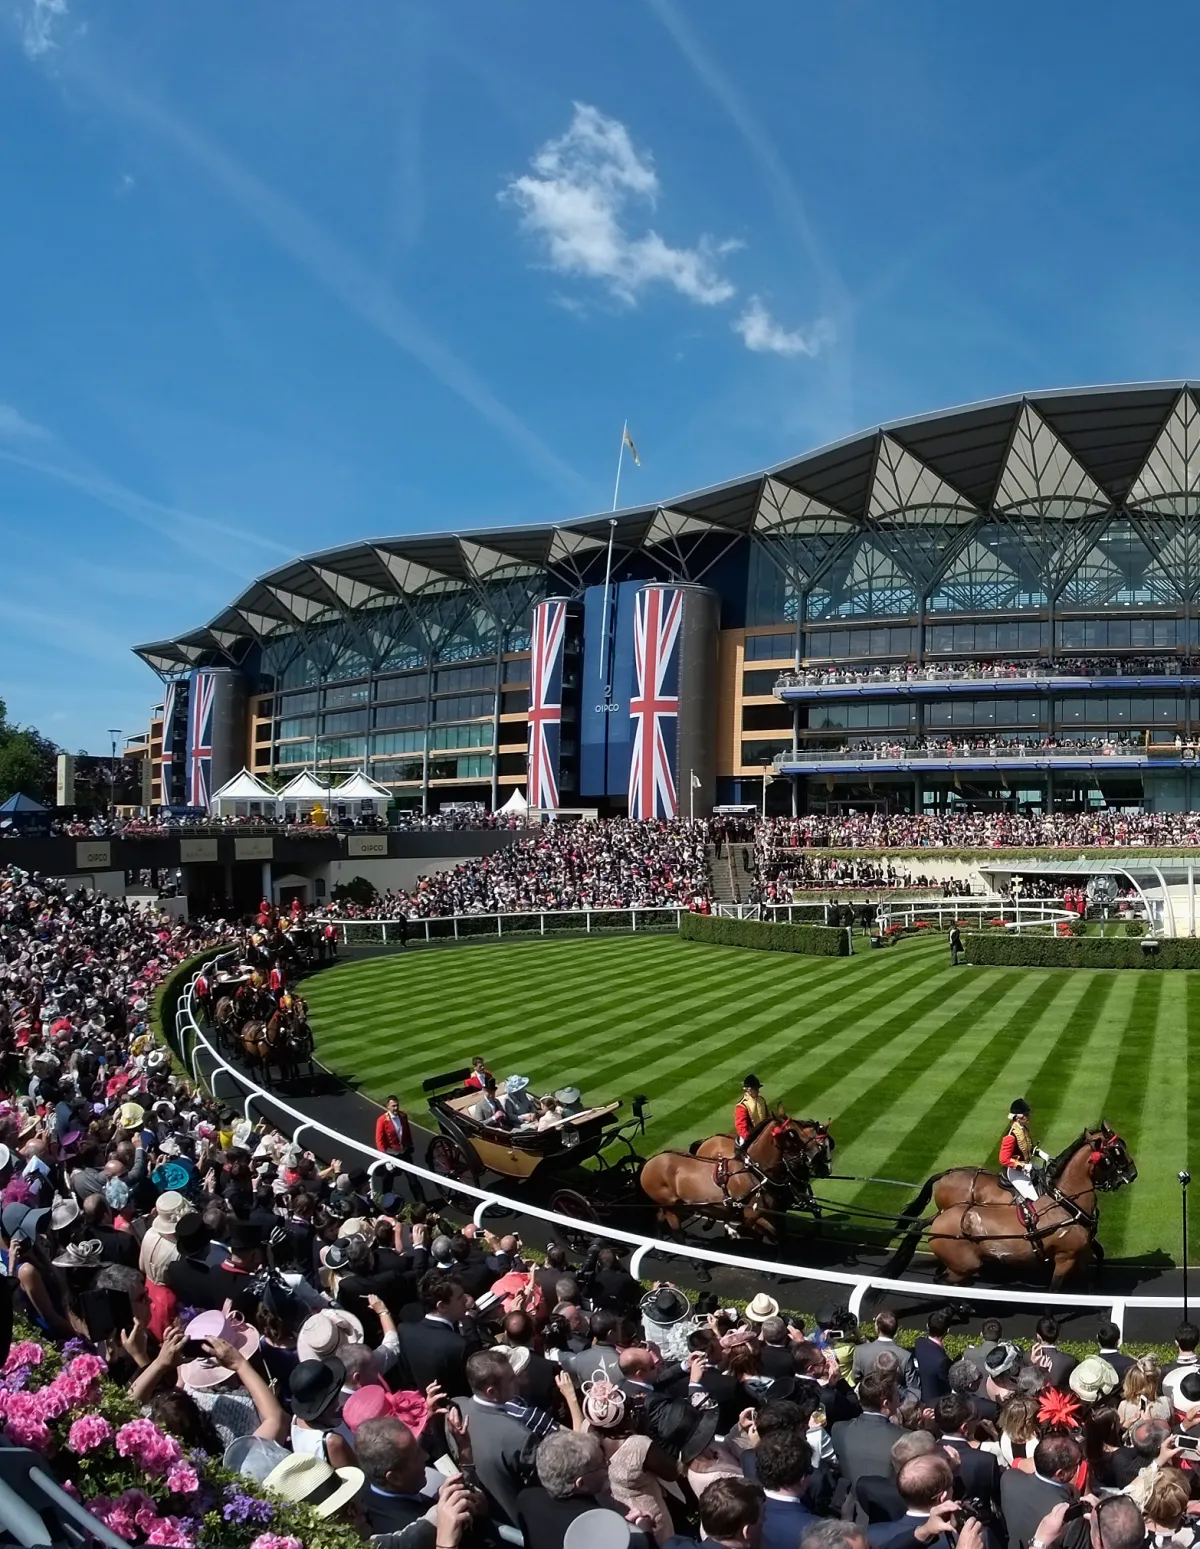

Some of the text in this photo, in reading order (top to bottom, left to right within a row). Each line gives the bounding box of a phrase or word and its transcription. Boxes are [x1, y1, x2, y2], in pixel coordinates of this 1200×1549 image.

[604, 685, 612, 698] 2
[595, 704, 619, 713] QIPCO
[361, 844, 383, 852] QIPCO
[87, 854, 107, 862] QIPCO
